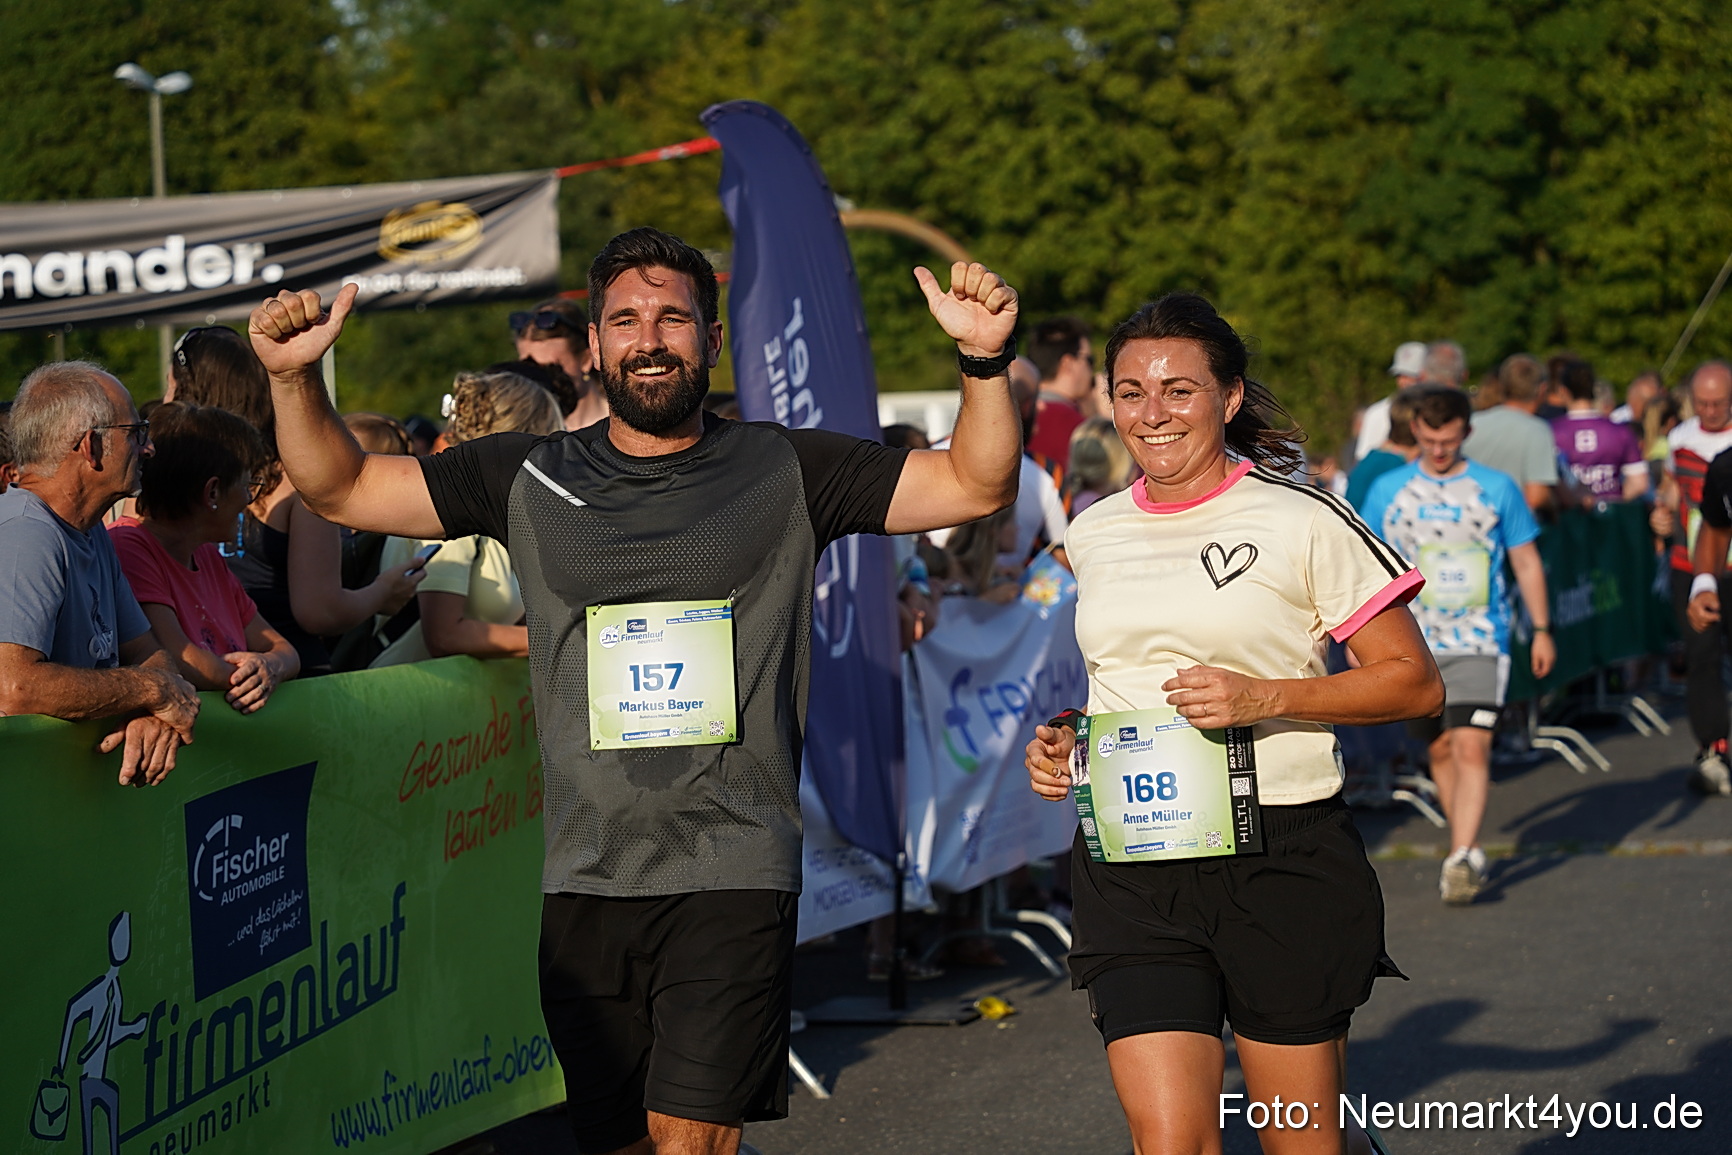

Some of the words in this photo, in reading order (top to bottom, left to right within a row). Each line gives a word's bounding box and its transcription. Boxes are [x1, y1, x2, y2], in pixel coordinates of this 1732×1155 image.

[621, 630, 664, 642] Firmenlauf
[637, 637, 663, 645] neumarkt
[629, 662, 684, 692] 157
[619, 700, 665, 712] Markus
[668, 699, 704, 712] Bayer
[1115, 738, 1154, 751] Firmenlauf
[1129, 745, 1154, 754] neumarkt
[1122, 771, 1179, 803] 168
[1123, 813, 1149, 825] Anne
[1152, 809, 1193, 822] Müller
[1237, 799, 1249, 843] HILTL
[212, 832, 290, 889] Fischer
[220, 865, 286, 907] AUTOMOBILE
[144, 880, 406, 1120] firmenlauf
